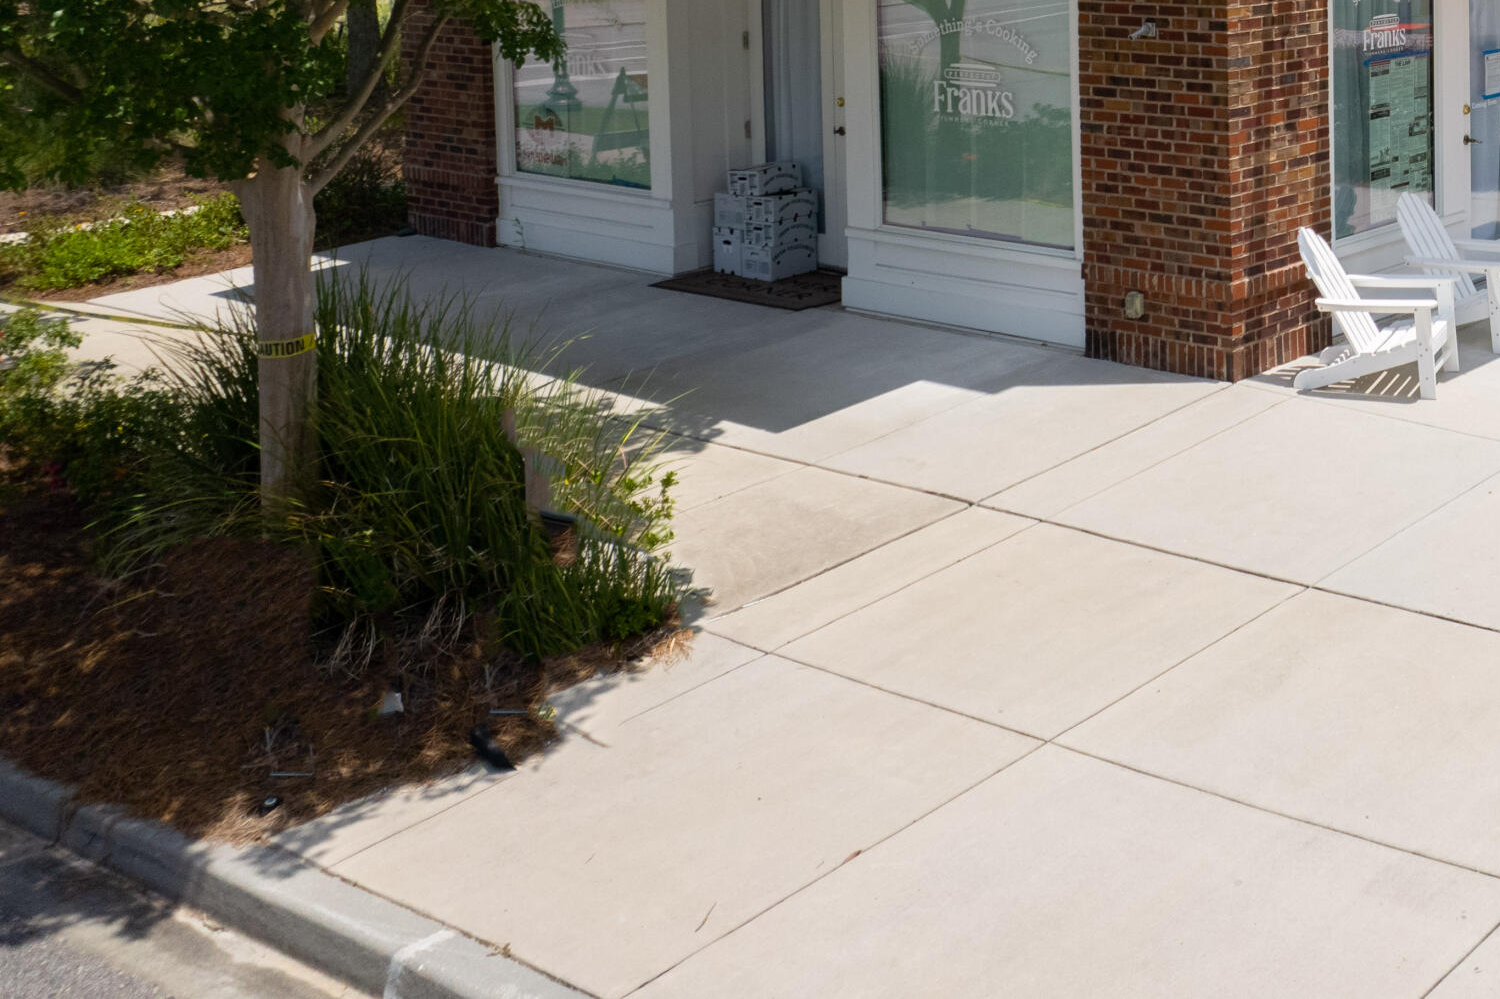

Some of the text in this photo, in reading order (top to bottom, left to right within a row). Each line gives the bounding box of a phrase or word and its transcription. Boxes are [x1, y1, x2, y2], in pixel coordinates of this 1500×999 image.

[909, 17, 1038, 65] Something's Cooking
[259, 338, 305, 356] AUTION
